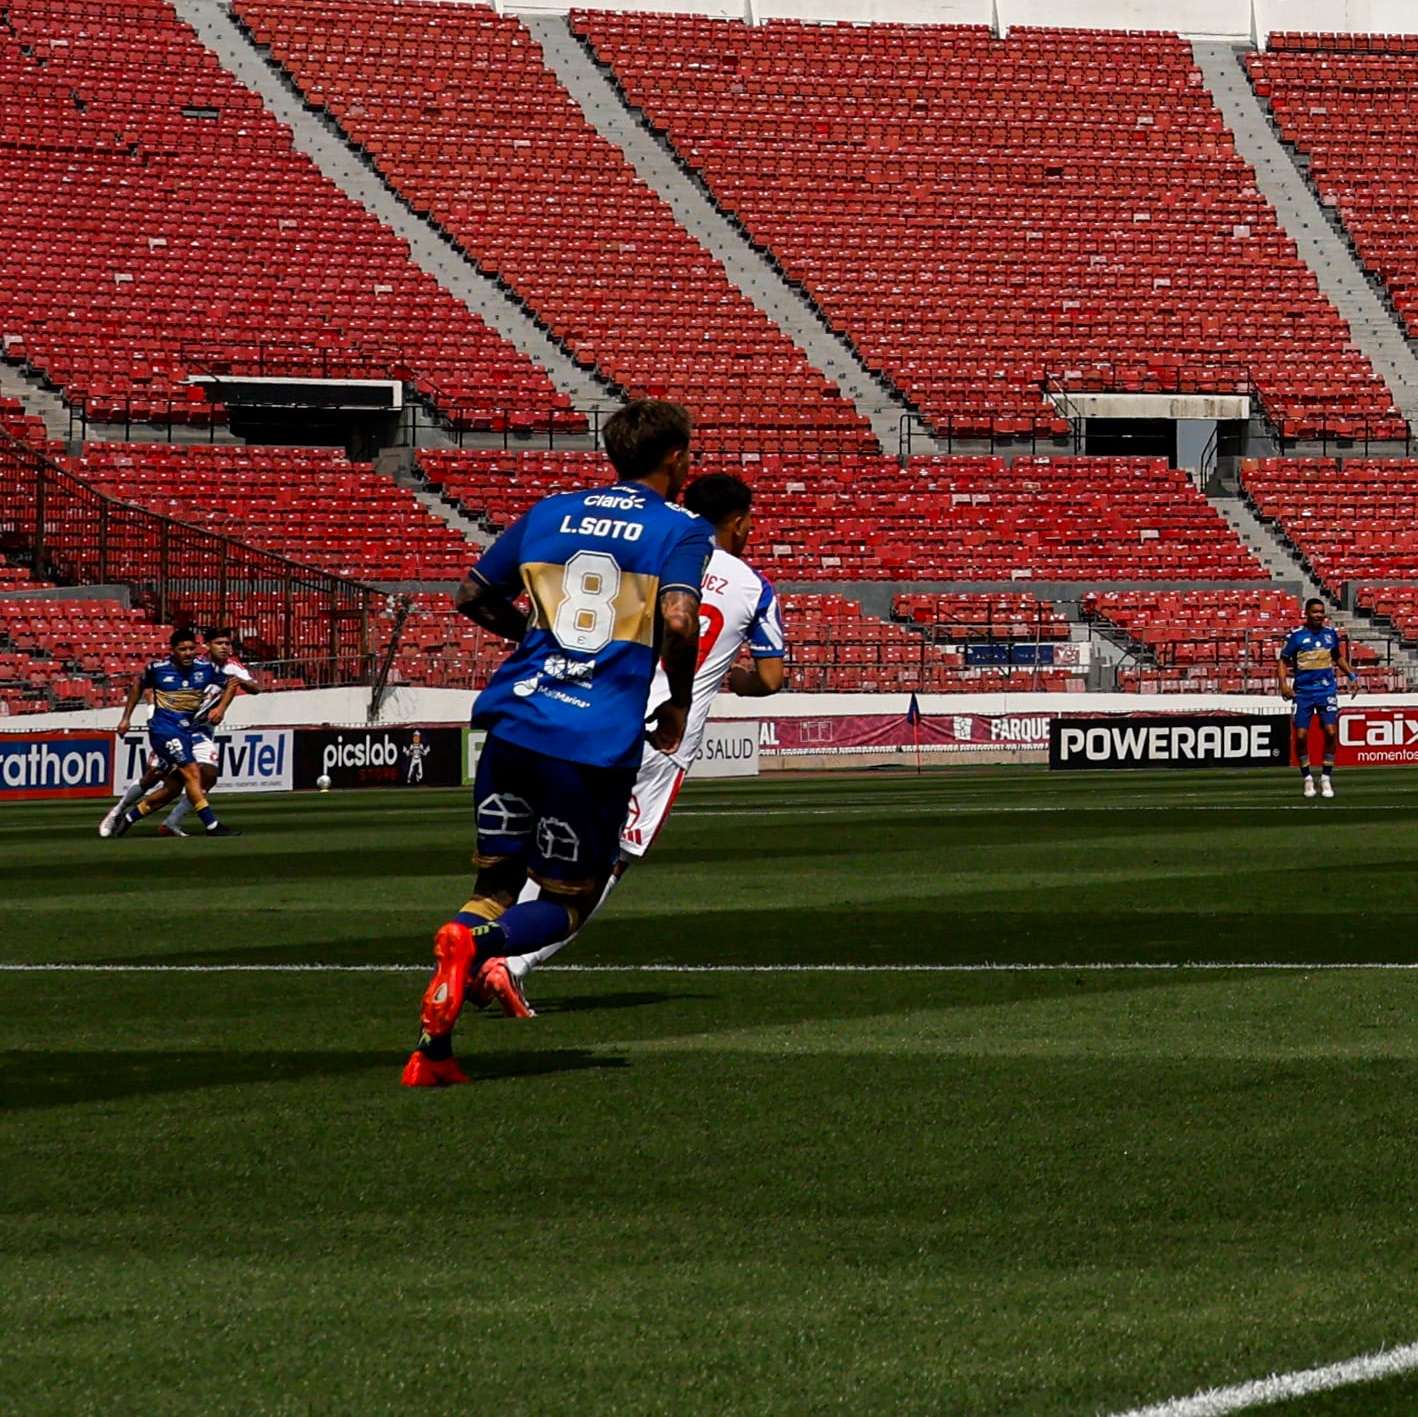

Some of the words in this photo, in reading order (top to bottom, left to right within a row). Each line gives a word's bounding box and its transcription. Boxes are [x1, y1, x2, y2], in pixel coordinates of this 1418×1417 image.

[584, 494, 634, 510] Claro
[560, 515, 643, 542] L.SOTO
[553, 549, 621, 654] 8
[991, 717, 1050, 741] PARQUE
[1060, 725, 1272, 761] POWERADE
[0, 744, 105, 786] athon
[214, 733, 285, 778] TvTel
[323, 733, 398, 775] picslab
[706, 738, 753, 760] SALUD
